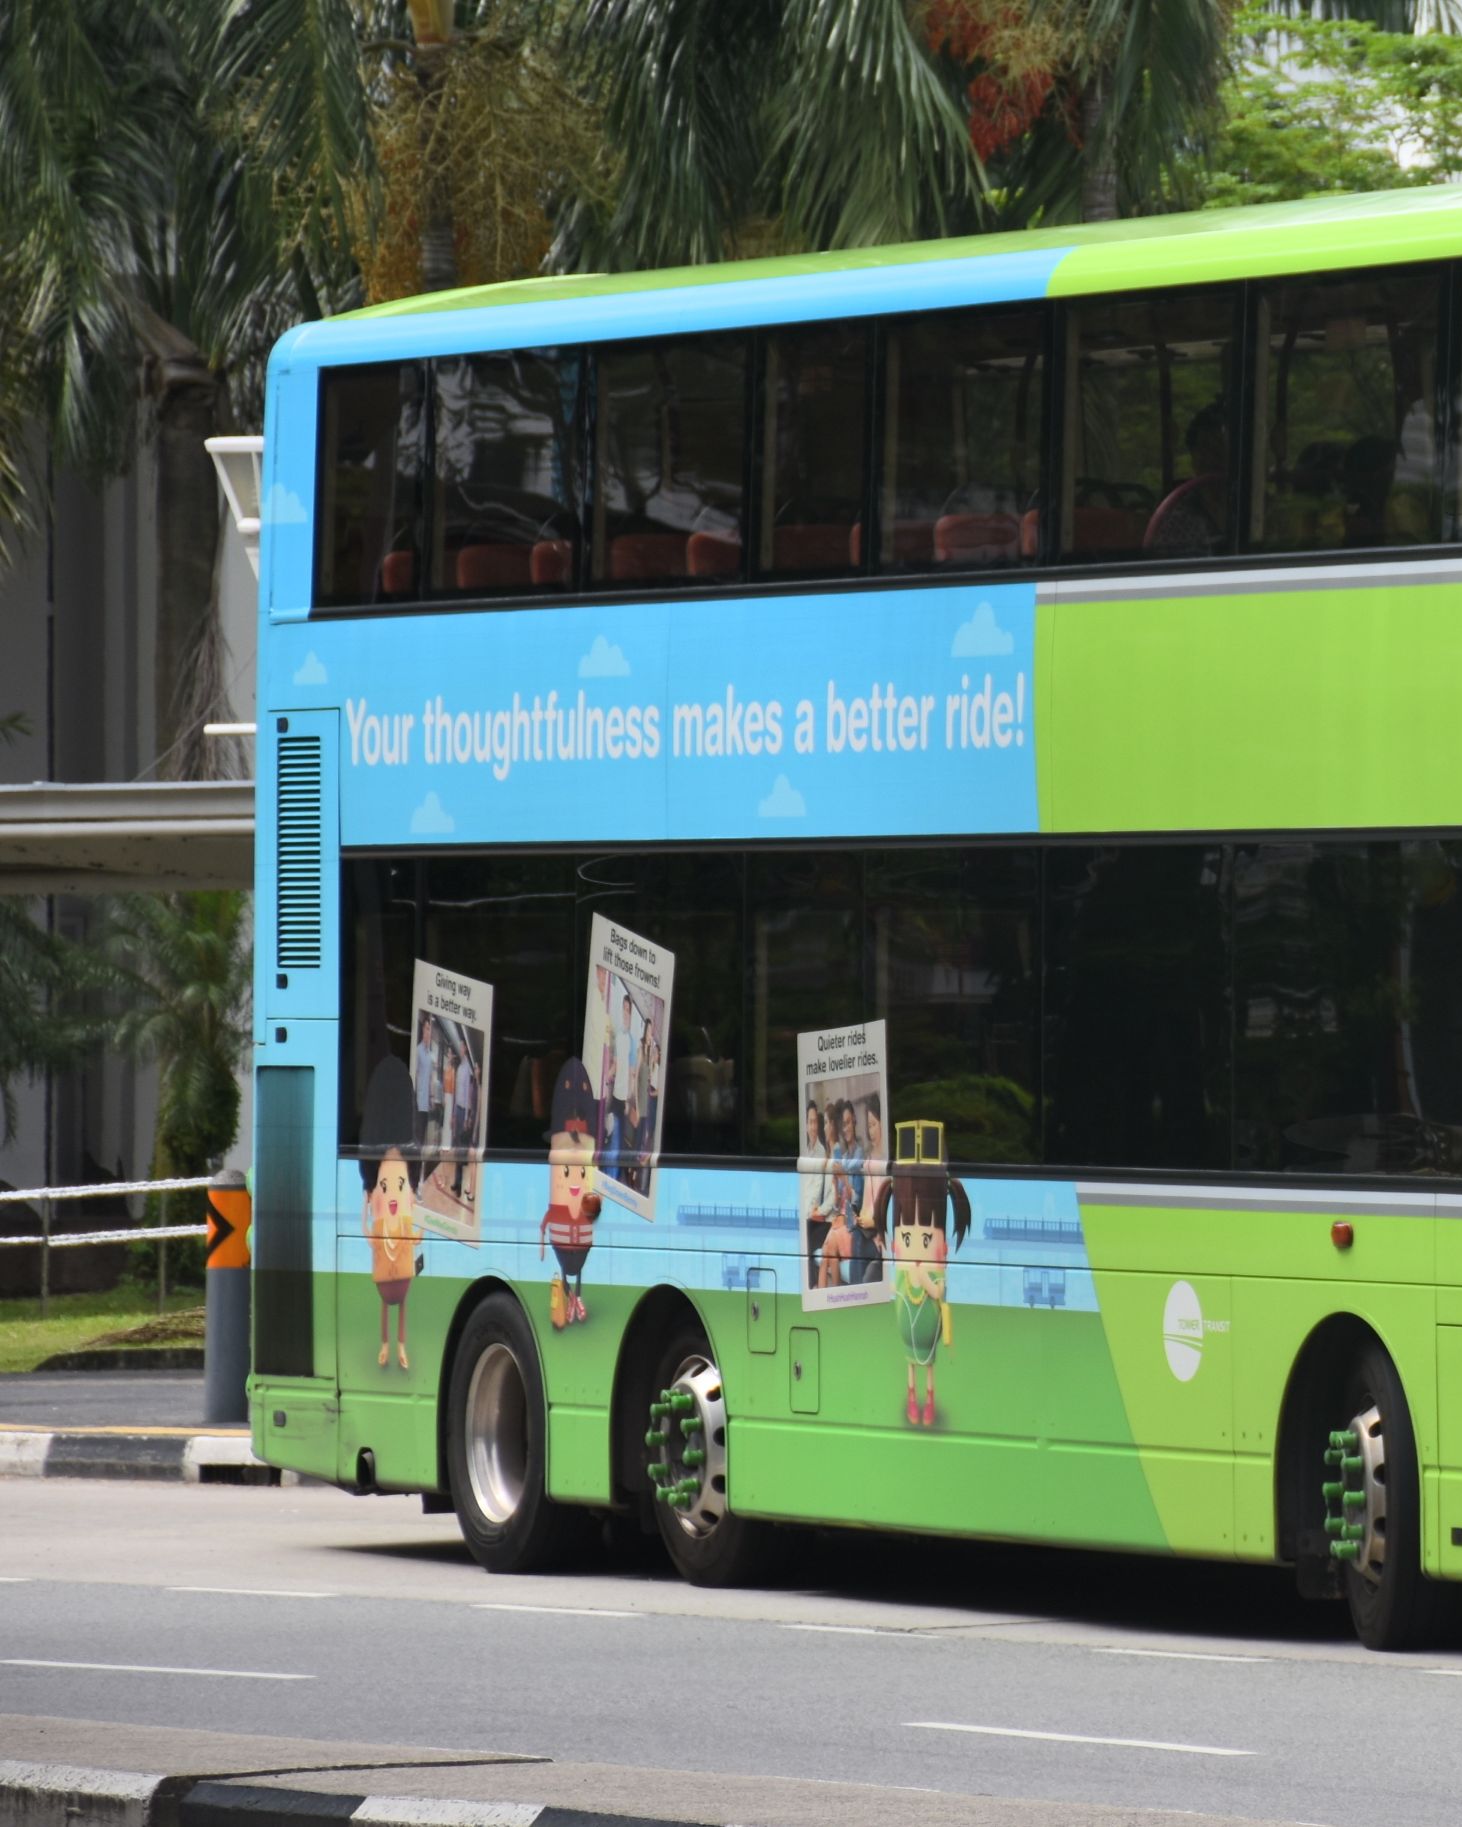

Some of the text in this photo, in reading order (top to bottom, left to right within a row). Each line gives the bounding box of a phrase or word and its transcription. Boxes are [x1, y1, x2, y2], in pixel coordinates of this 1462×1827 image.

[346, 675, 1025, 782] Your thoughtfulness makes a better ride!
[610, 928, 656, 965] Bags down to
[614, 952, 634, 975] those
[635, 963, 660, 989] frowns!
[435, 972, 472, 1001] Giving way
[440, 995, 461, 1015] better
[817, 1030, 866, 1052] Quieter rides
[806, 1059, 827, 1076] make
[828, 1054, 856, 1072] lovelier
